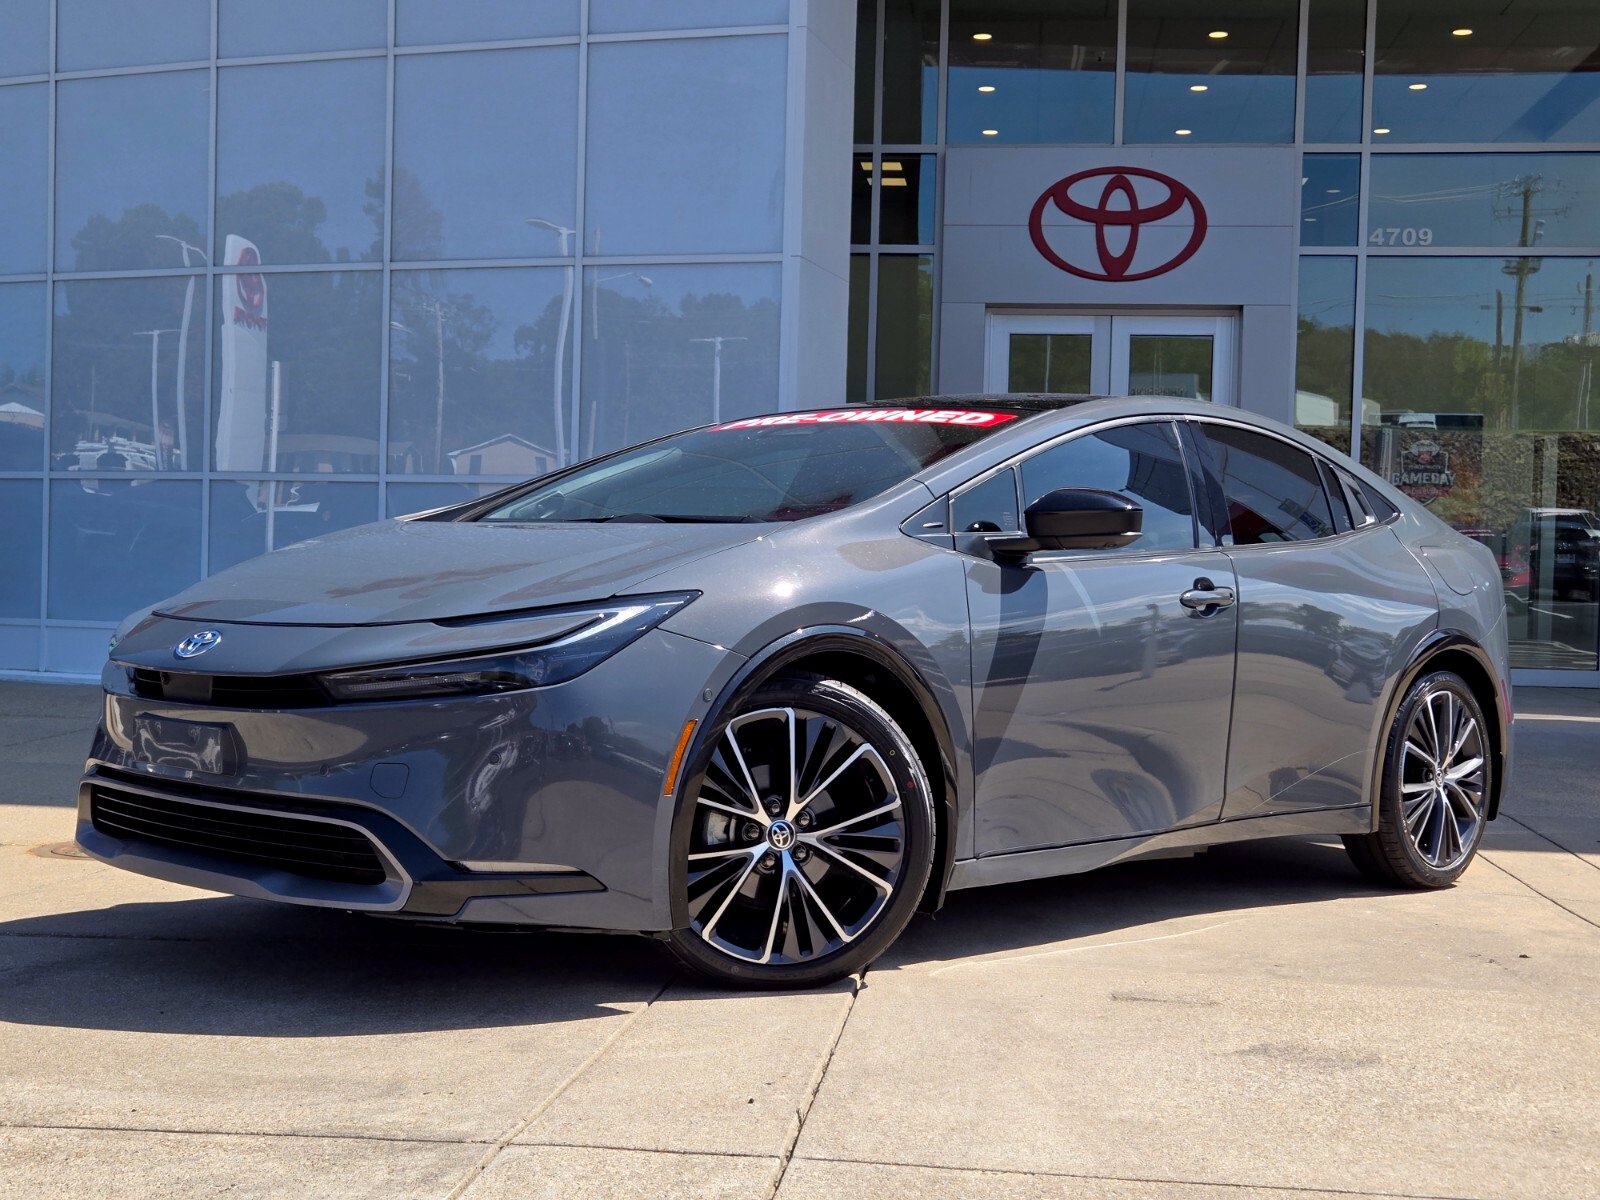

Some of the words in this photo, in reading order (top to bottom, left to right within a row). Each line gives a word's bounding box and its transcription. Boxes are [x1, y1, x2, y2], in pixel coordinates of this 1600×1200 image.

[1368, 228, 1433, 246] 4709
[719, 410, 995, 430] PRE-OWNED
[1391, 472, 1456, 486] GAMEDAY
